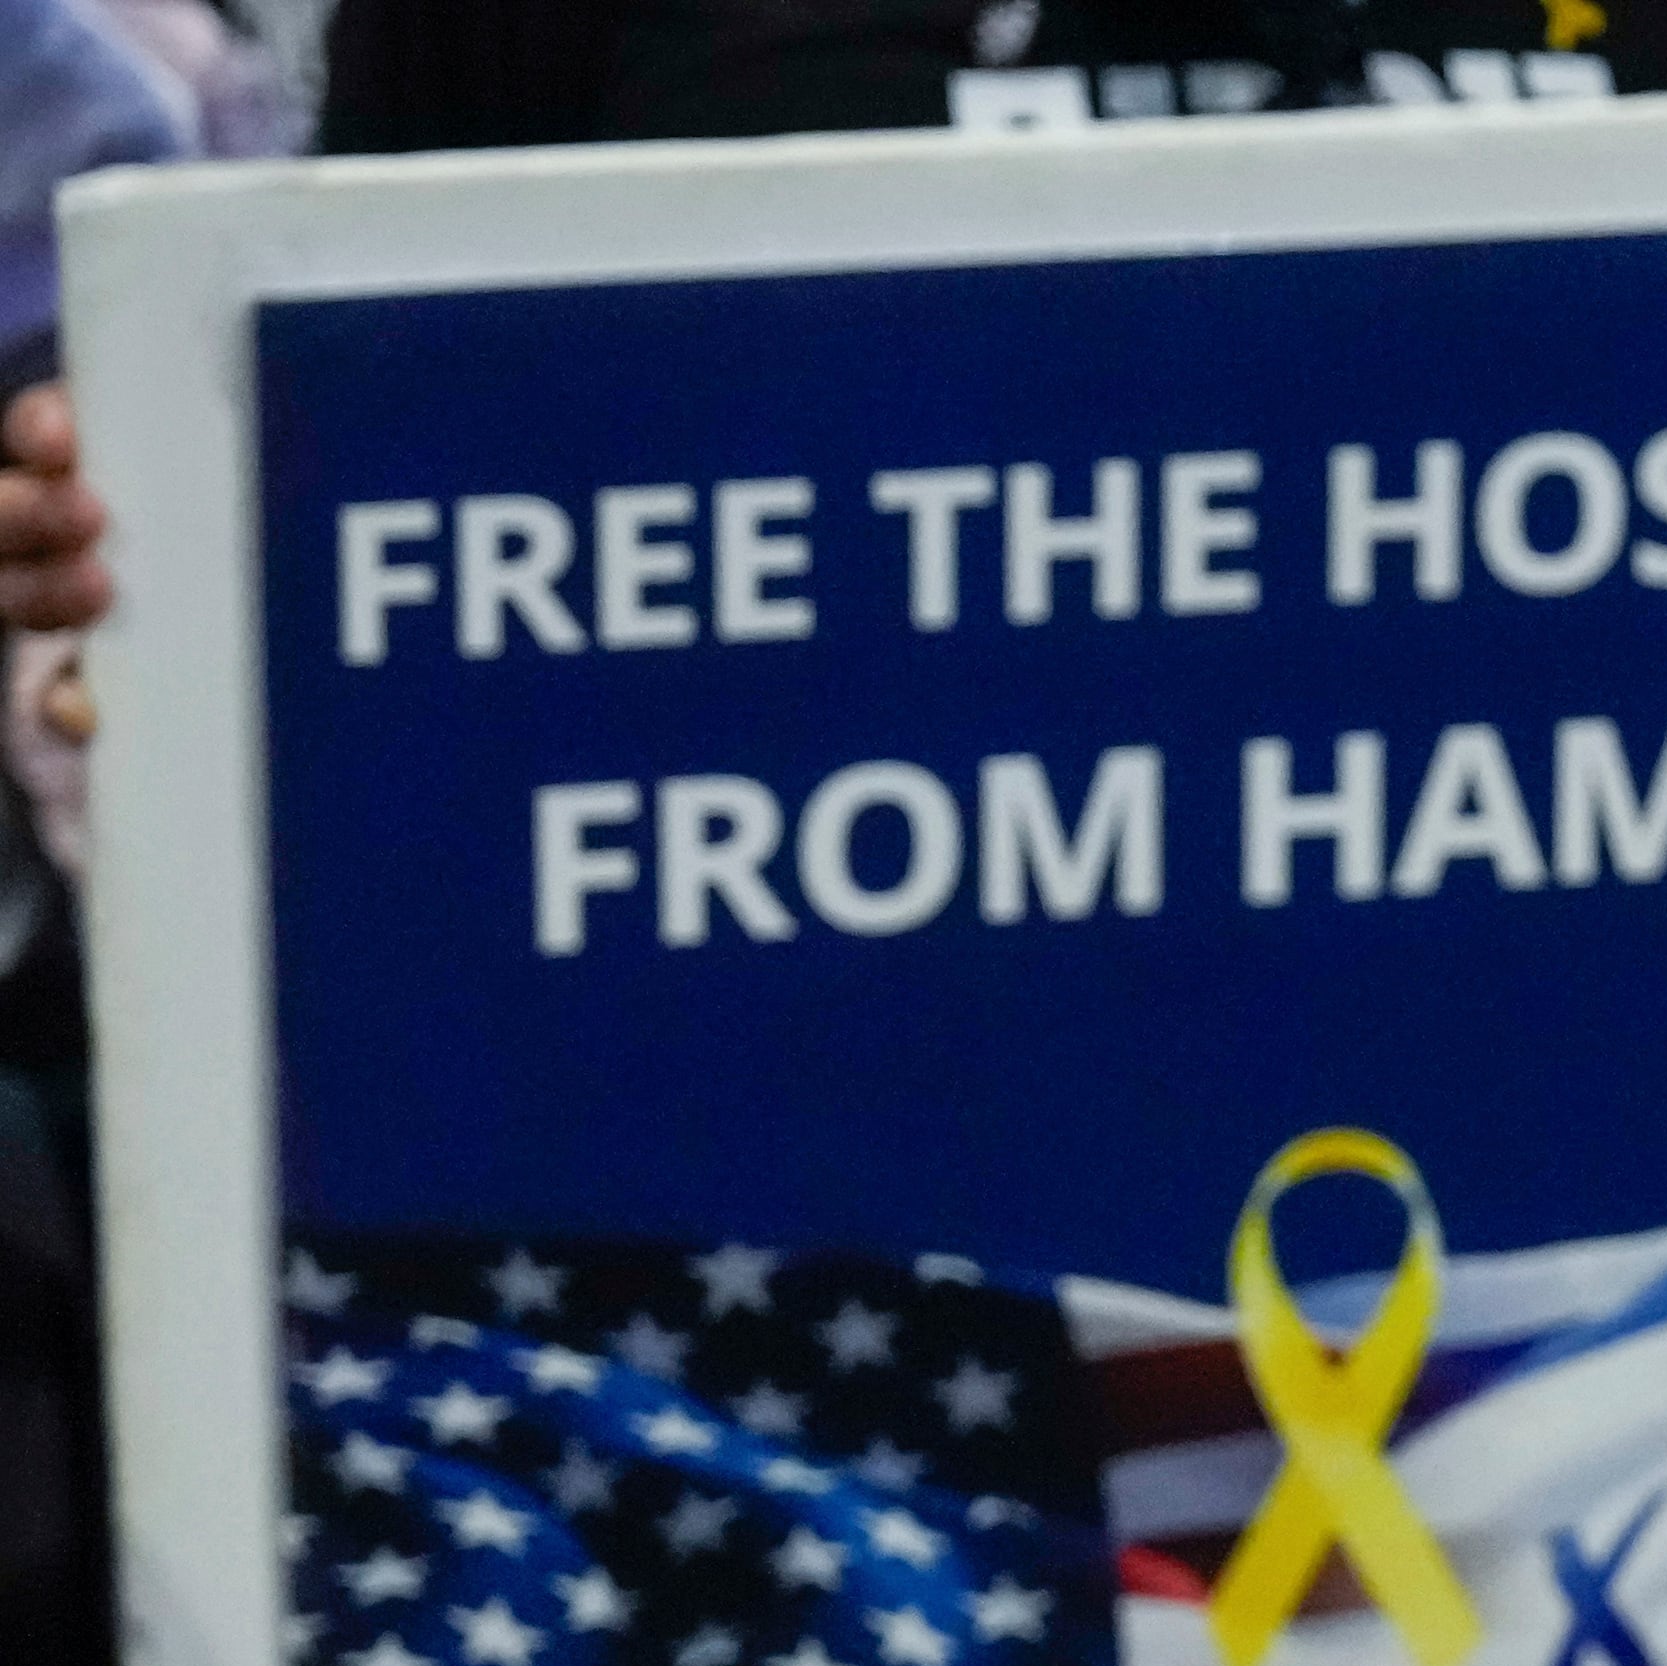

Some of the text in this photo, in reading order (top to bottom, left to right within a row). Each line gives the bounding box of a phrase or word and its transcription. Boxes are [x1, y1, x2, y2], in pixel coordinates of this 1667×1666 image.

[340, 480, 813, 664] FREE
[873, 453, 1258, 626] THE
[536, 747, 1161, 954] FROM
